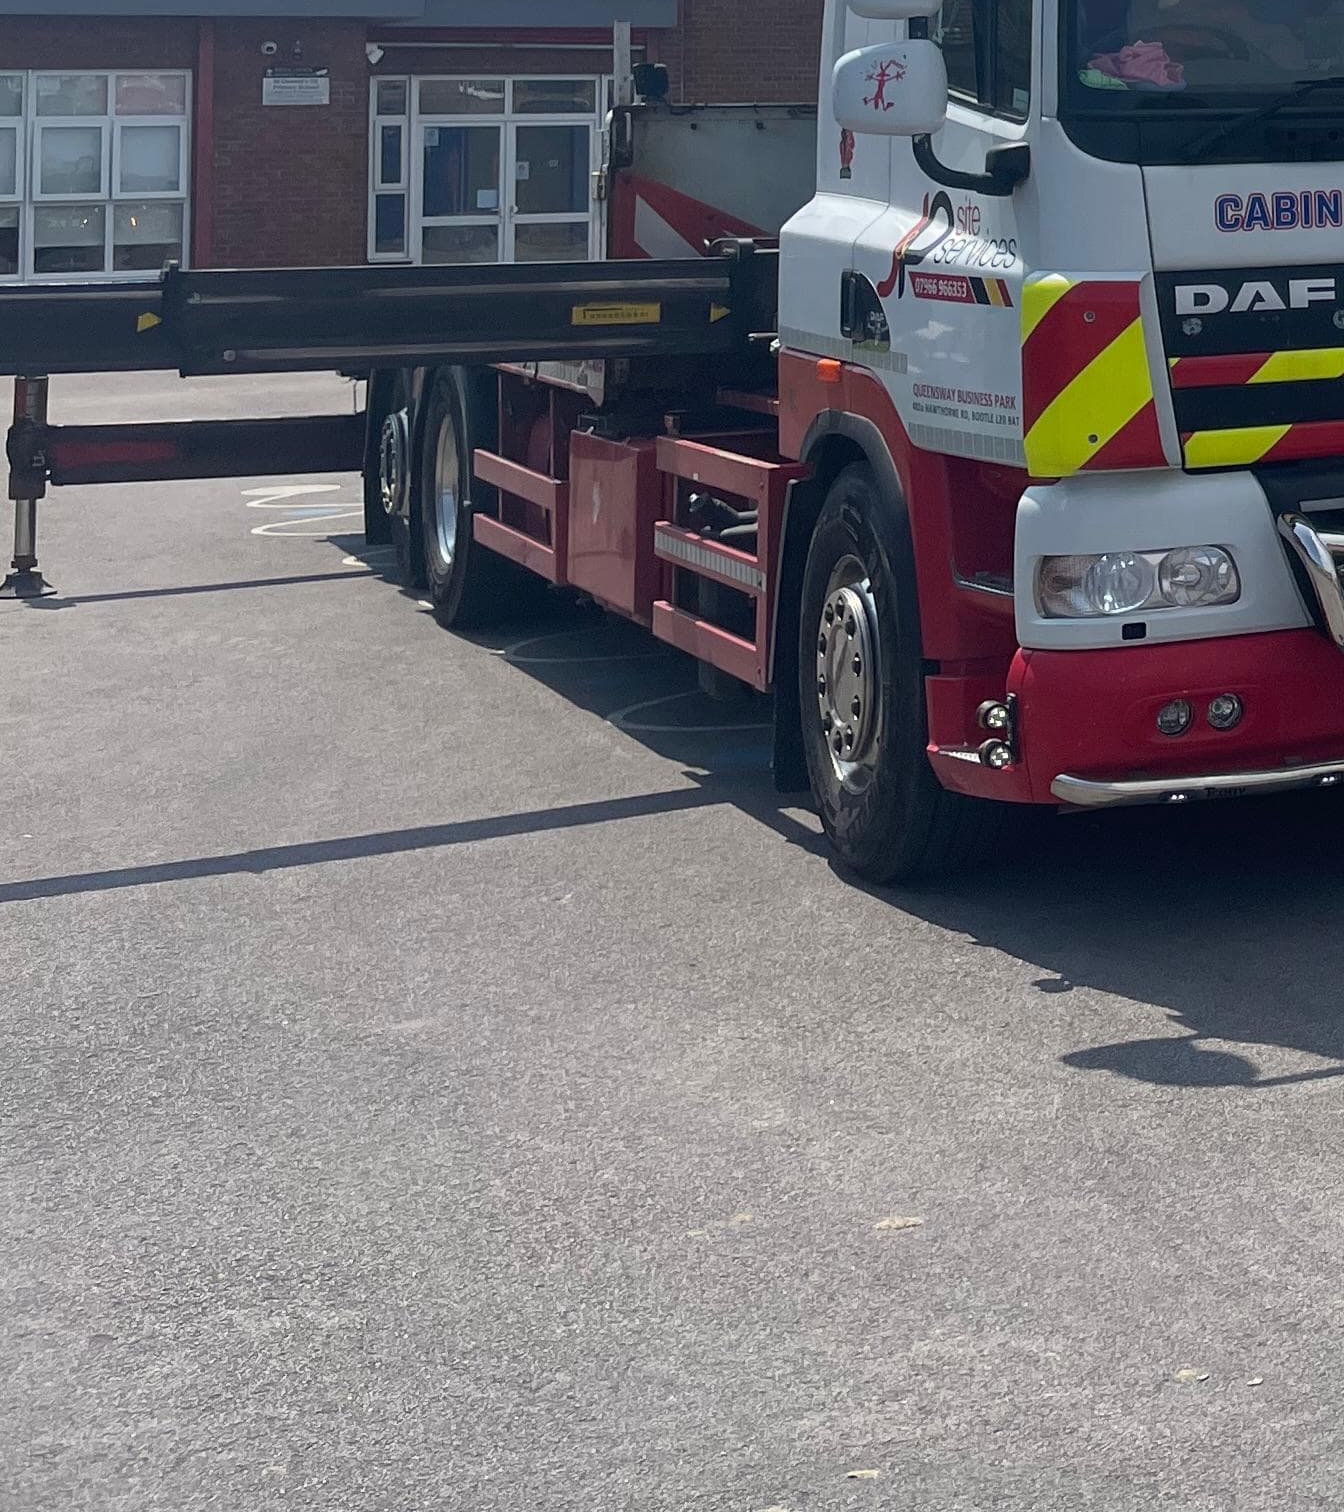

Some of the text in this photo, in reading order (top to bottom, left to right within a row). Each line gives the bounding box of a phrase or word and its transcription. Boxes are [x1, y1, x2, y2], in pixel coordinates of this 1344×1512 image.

[955, 196, 981, 236] site
[1213, 189, 1342, 233] CABIN
[933, 228, 1018, 269] services
[915, 278, 967, 297] 07966 966353
[1174, 277, 1337, 316] DAF
[912, 383, 1017, 410] QUEENSWAY BUSINESS PARK
